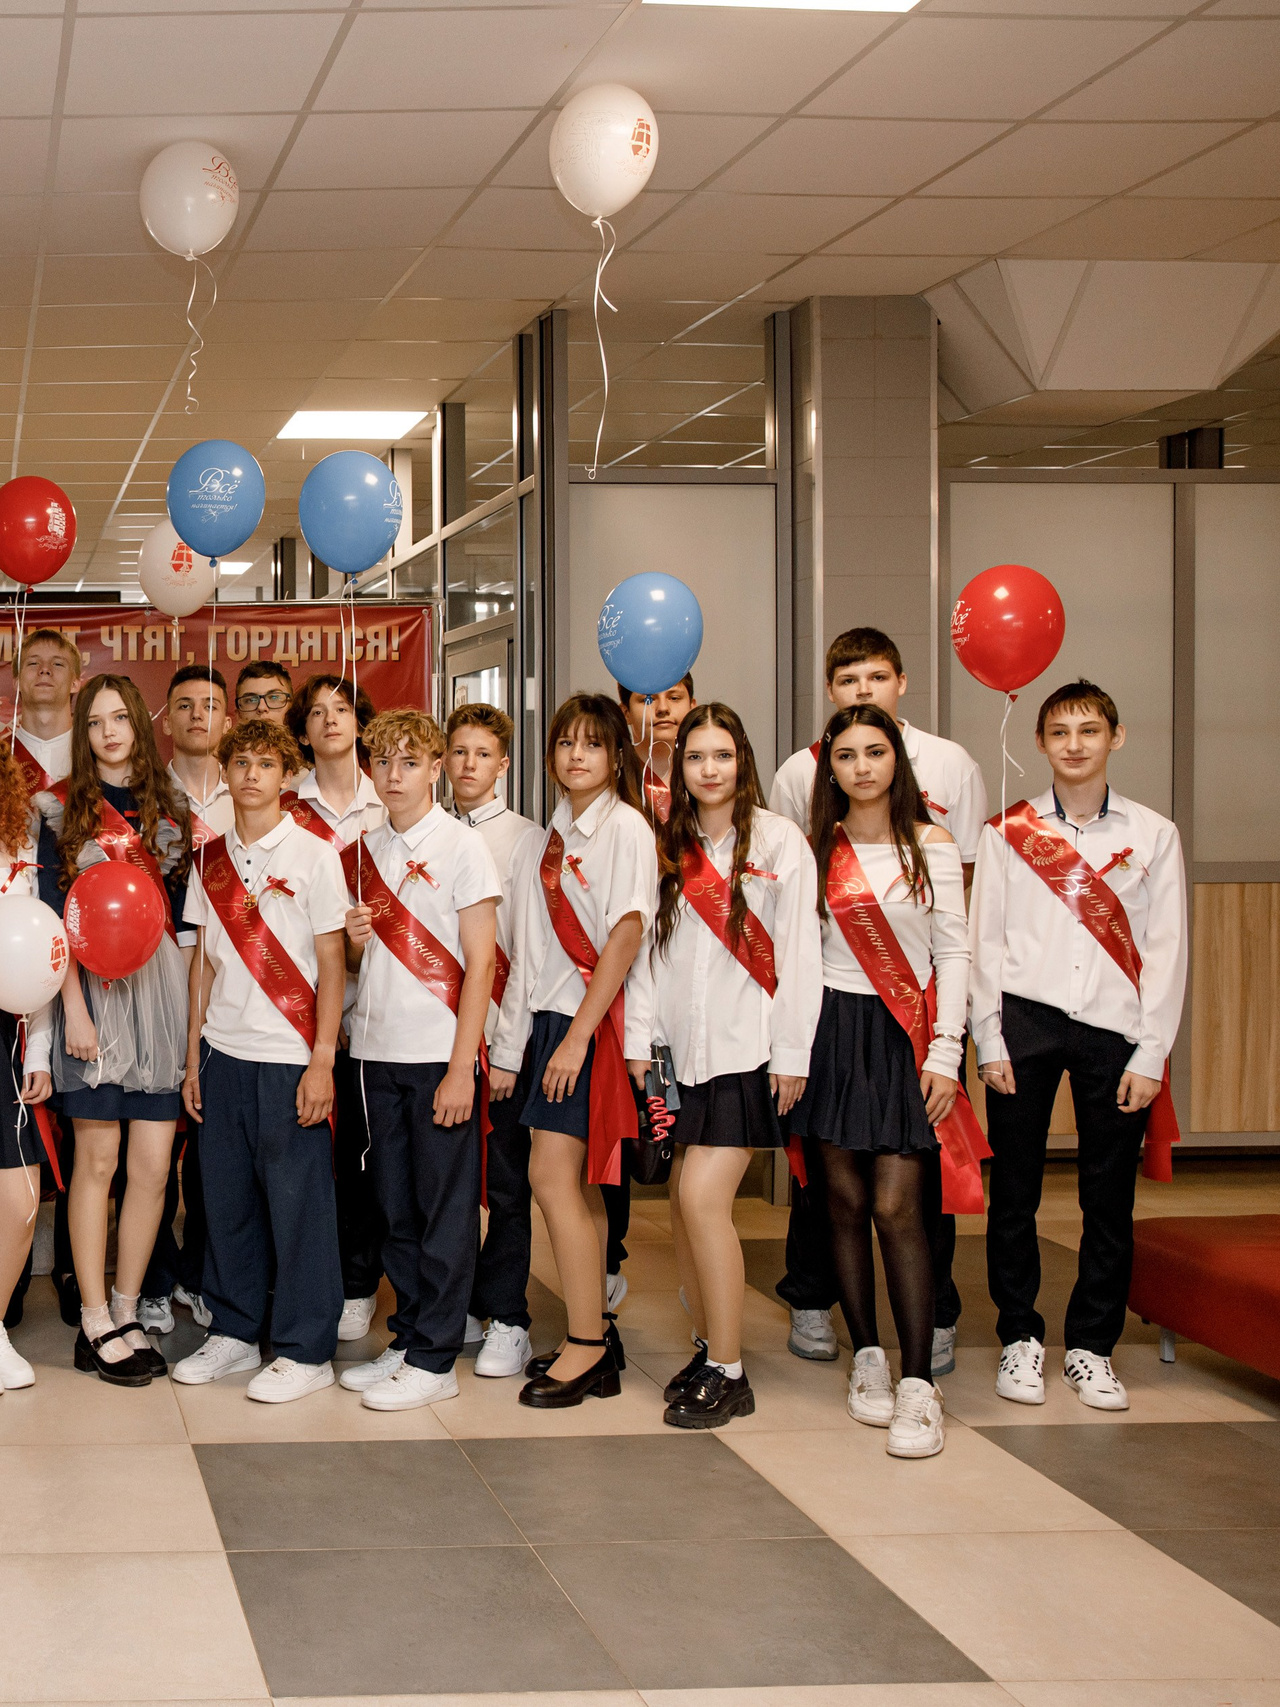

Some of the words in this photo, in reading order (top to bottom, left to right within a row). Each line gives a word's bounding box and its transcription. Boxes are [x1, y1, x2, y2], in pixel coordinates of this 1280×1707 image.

[188, 467, 241, 495] Всё
[197, 492, 233, 502] только
[100, 625, 195, 665] ЧТЯТ,
[208, 625, 401, 667] ГОРДЯТСЯ!
[217, 888, 288, 981] Выпускник
[366, 891, 444, 969] Выпускник
